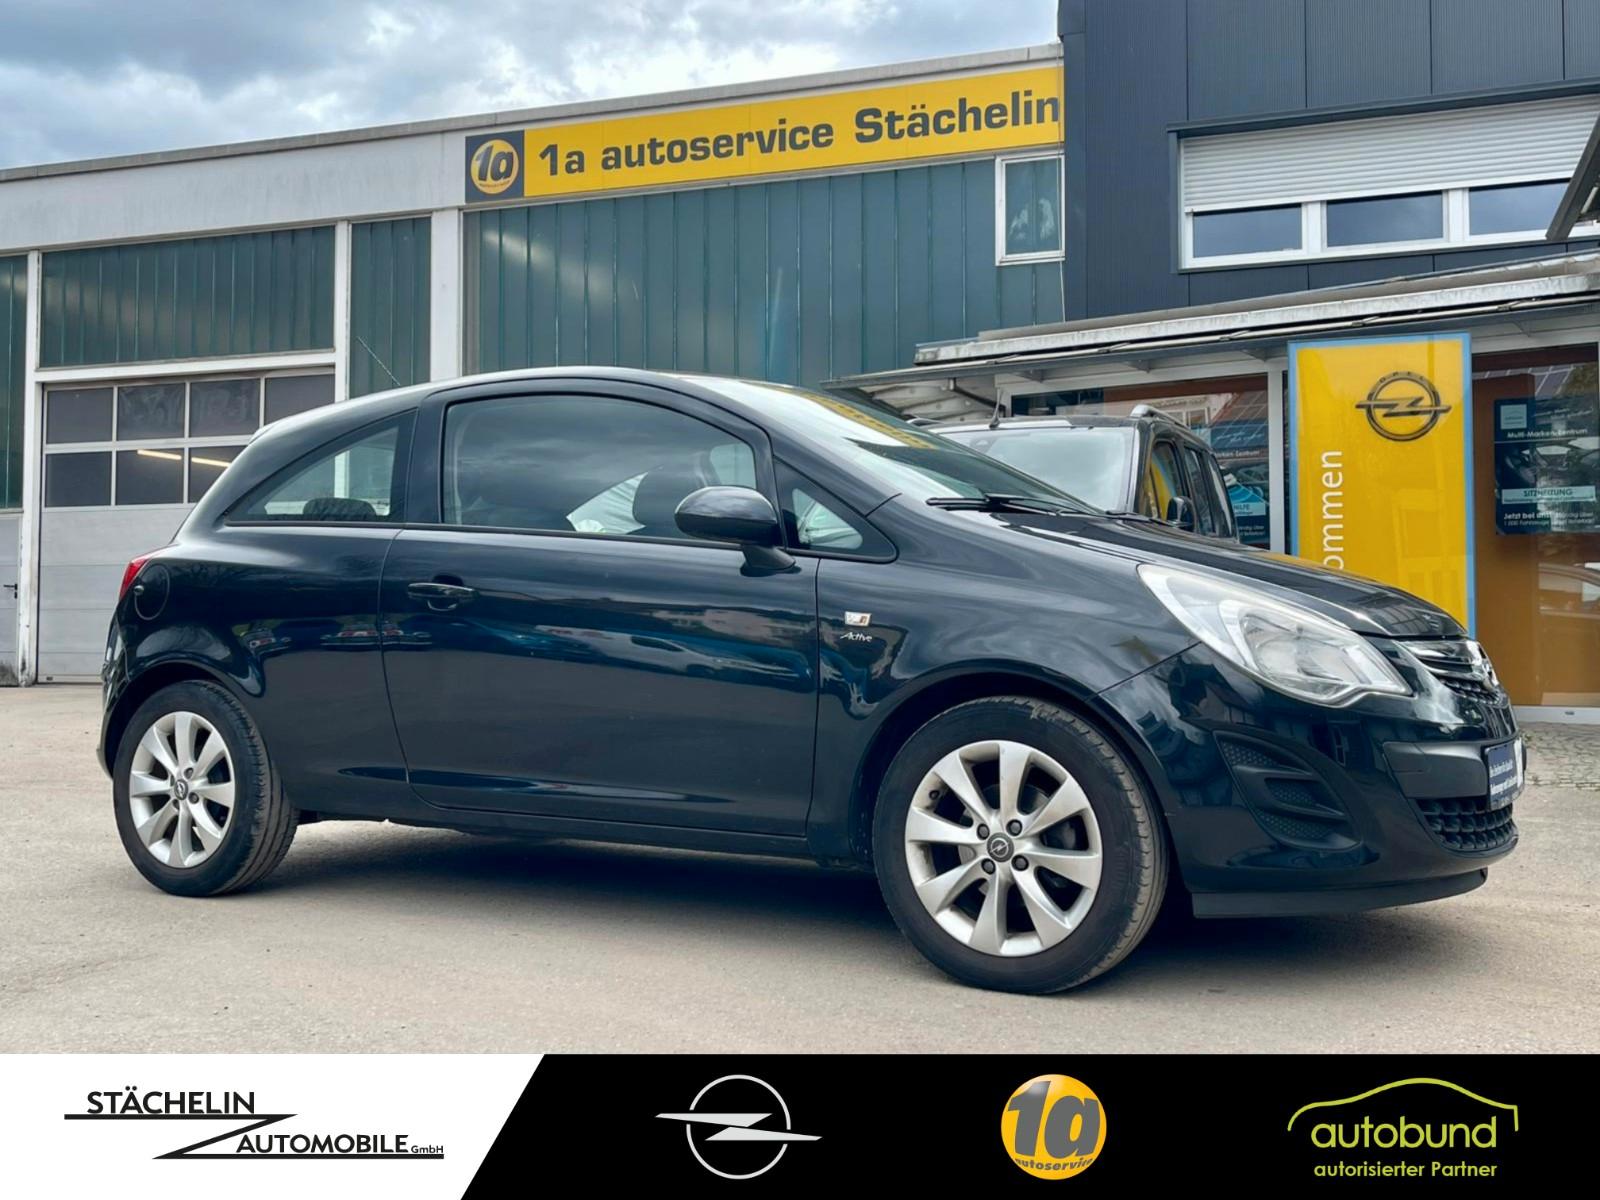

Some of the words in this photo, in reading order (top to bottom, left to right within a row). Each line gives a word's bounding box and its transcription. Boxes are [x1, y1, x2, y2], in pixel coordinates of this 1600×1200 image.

[475, 144, 514, 181] 1a
[539, 144, 585, 176] 1a
[601, 118, 834, 170] autoservice
[855, 90, 1059, 143] Stächelin
